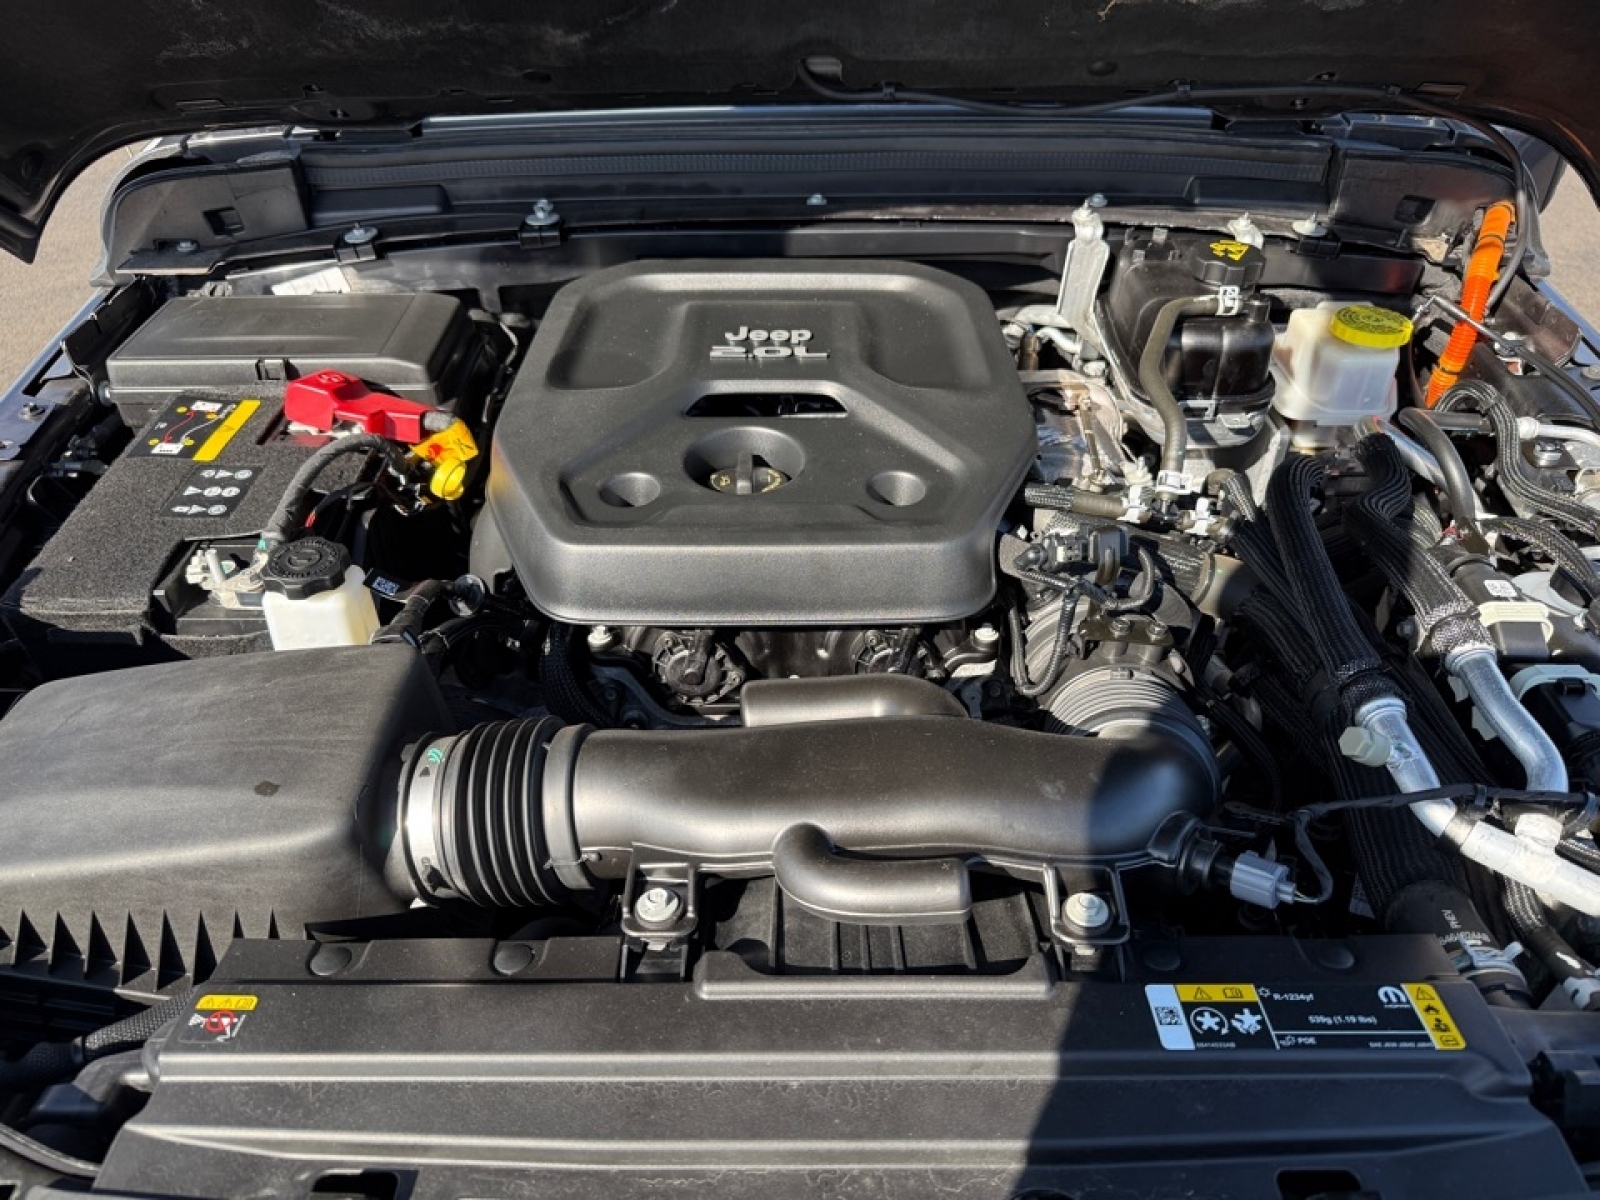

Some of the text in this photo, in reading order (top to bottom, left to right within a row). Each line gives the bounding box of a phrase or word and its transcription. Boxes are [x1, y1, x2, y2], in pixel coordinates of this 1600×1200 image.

[724, 326, 812, 344] Jeep
[709, 345, 828, 358] 2.0L
[1272, 992, 1314, 1002] R-1234yf
[1297, 1037, 1317, 1045] POE
